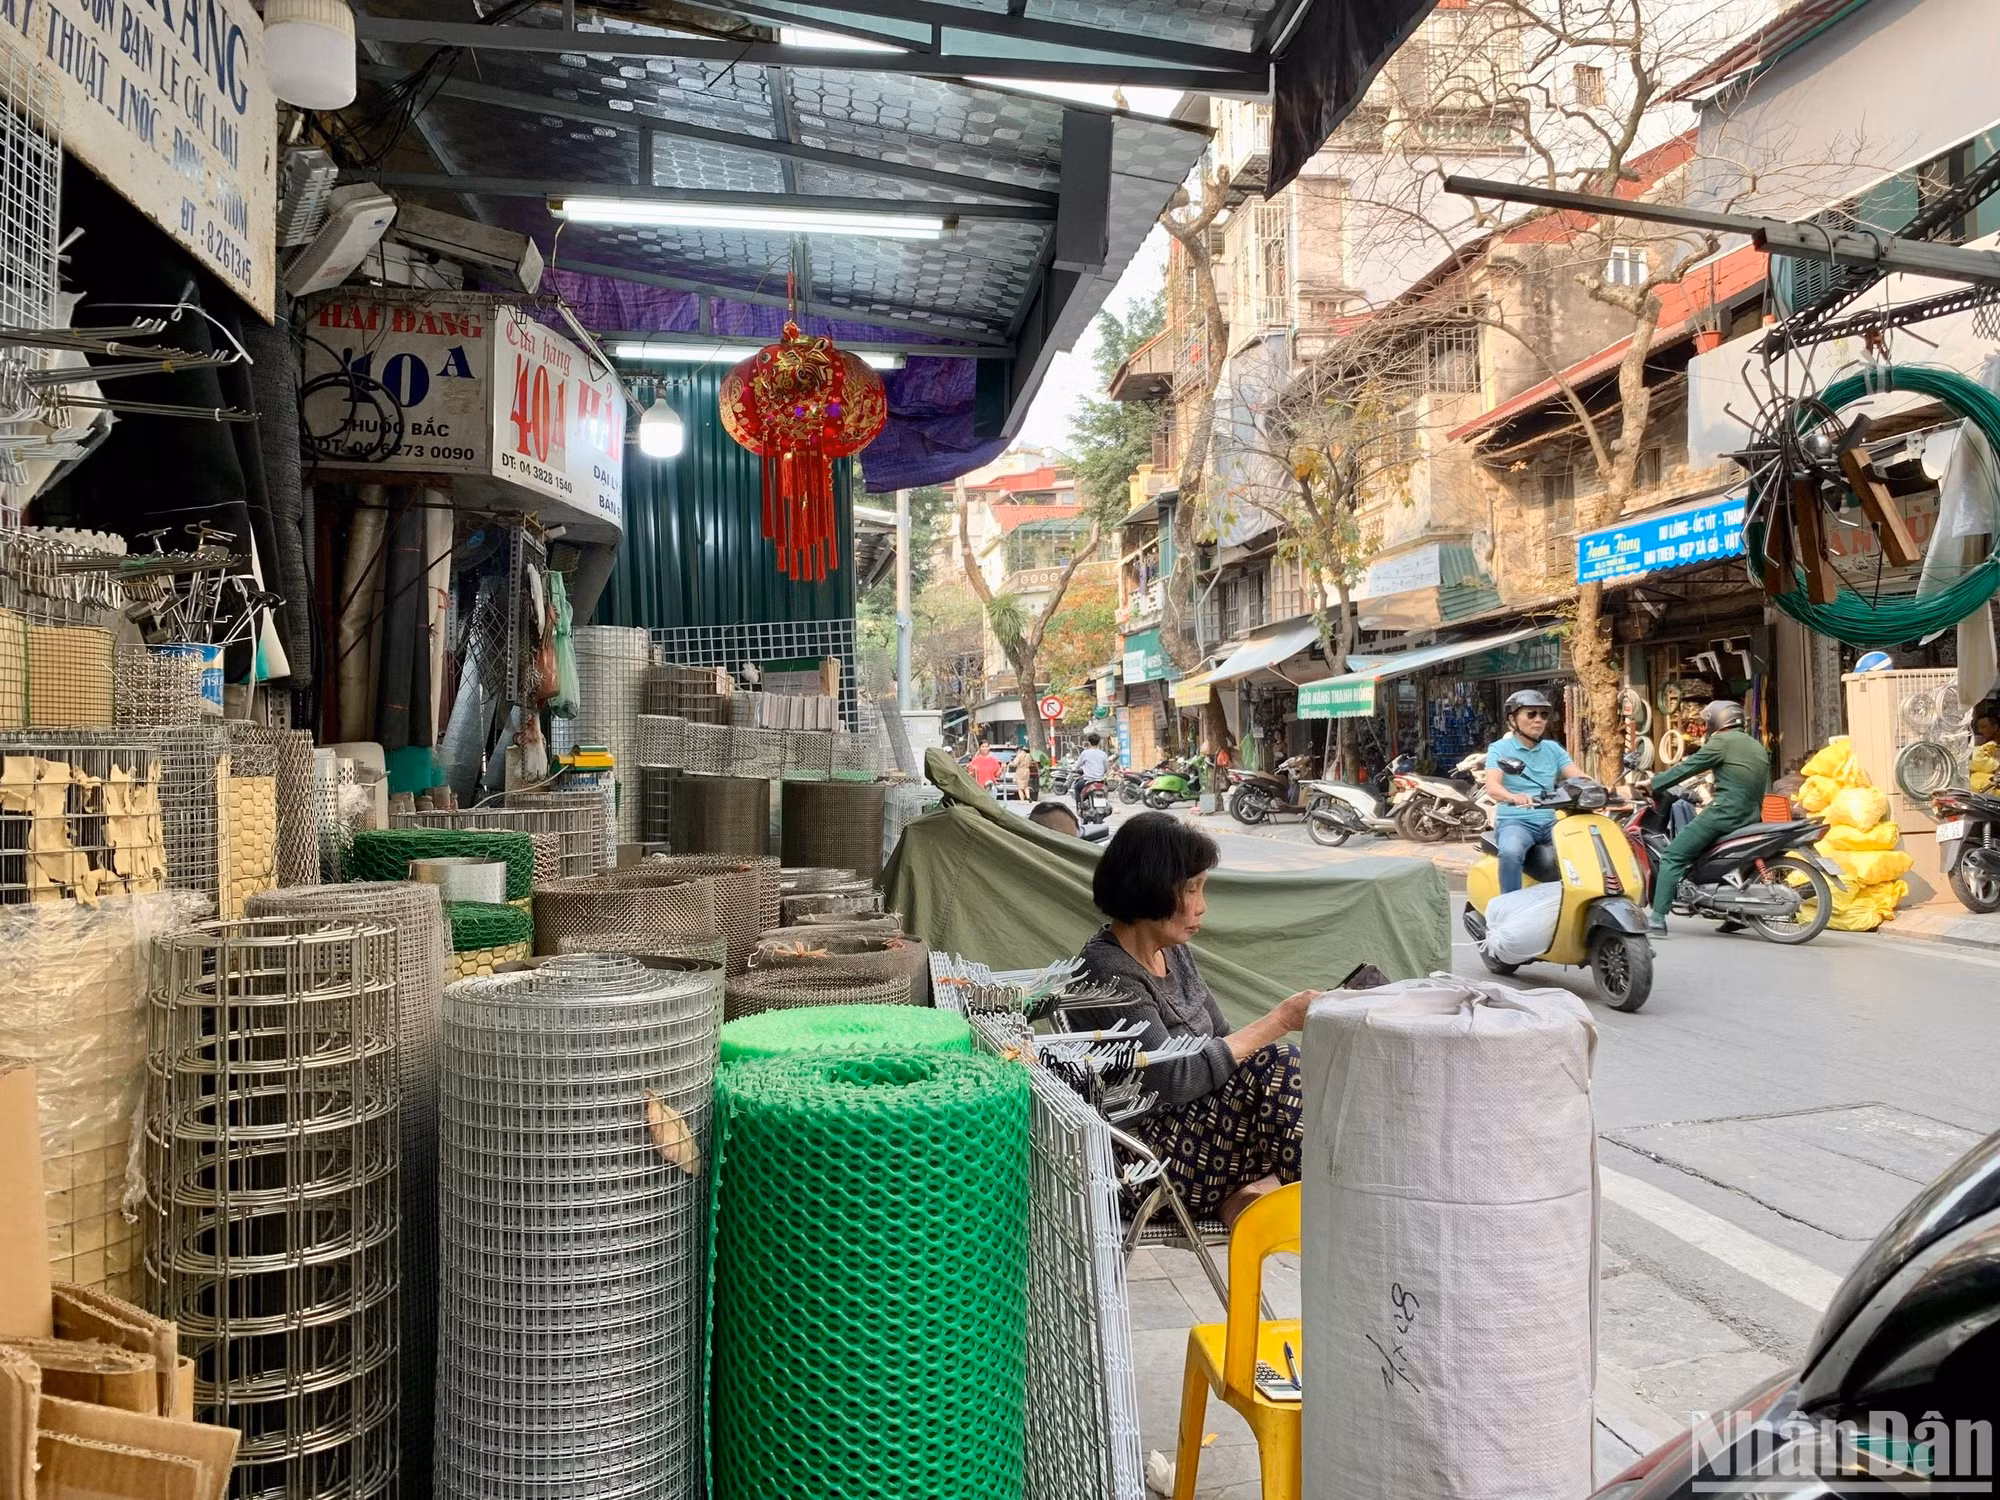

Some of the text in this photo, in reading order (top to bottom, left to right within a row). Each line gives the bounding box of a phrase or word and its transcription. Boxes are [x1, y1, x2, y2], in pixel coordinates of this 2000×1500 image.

[184, 74, 207, 136] CÁC
[411, 416, 450, 437] BẮC
[430, 445, 475, 460] 0090
[519, 460, 532, 476] 04
[533, 463, 554, 486] 3828
[555, 475, 573, 494] 1540
